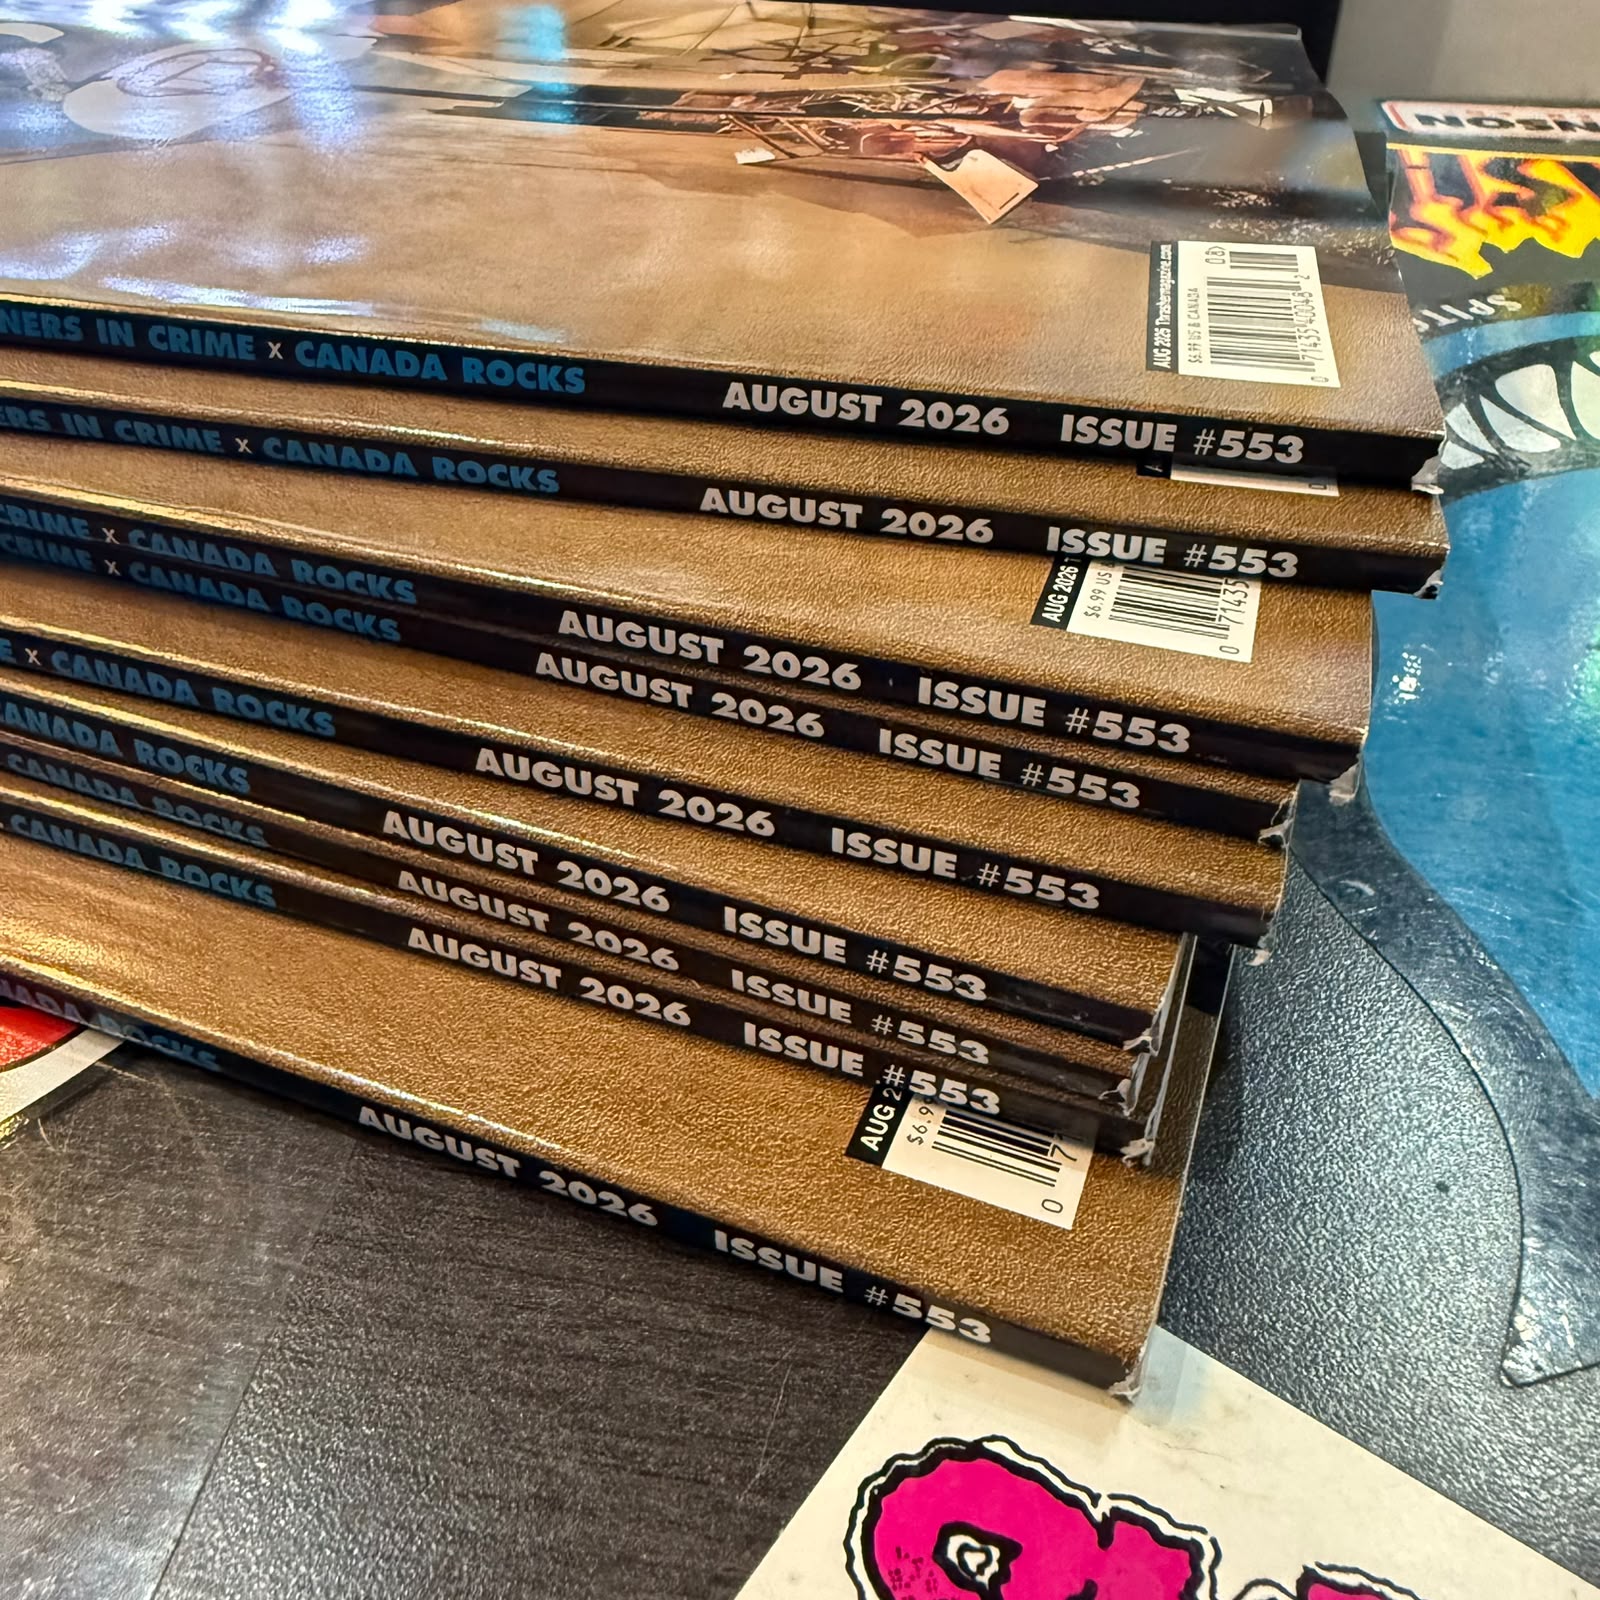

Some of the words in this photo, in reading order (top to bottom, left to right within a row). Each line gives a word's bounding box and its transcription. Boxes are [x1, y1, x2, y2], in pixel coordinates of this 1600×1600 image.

[0, 405, 51, 431] RS
[61, 412, 104, 438] IN
[116, 419, 223, 452] CRIME
[262, 437, 417, 477] CANADA
[432, 456, 560, 494] ROCKS
[700, 486, 863, 529] AUGUST
[881, 509, 994, 544] 2026
[1047, 526, 1166, 565] ISSUE
[1184, 543, 1298, 579] #553
[96, 318, 136, 347] IN
[149, 326, 256, 361] CRIME
[295, 342, 447, 382] CANADA
[462, 356, 586, 395] ROCKS
[723, 382, 882, 423] AUGUST
[898, 398, 1009, 435] 2026
[1061, 414, 1177, 452] ISSUE
[1194, 427, 1304, 464] #553
[128, 529, 278, 577] CANADA
[291, 559, 417, 605] ROCKS
[559, 610, 724, 665] AUGUST
[742, 644, 861, 691] 2026
[917, 677, 1046, 727] ISSUE
[1064, 707, 1190, 754] #553
[129, 561, 271, 612] CANADA
[282, 595, 401, 641] ROCKS
[535, 652, 692, 708] AUGUST
[711, 692, 825, 739] 2026
[879, 729, 1001, 780] ISSUE
[1020, 761, 1140, 809] #553
[1042, 590, 1069, 623] AUG
[1055, 565, 1079, 594] 2026
[1097, 571, 1113, 586] US
[0, 702, 123, 758] ANADA
[134, 738, 250, 795] ROCKS
[382, 810, 538, 875] AUGUST
[557, 861, 670, 913] 2026
[724, 906, 846, 964] ISSUE
[866, 949, 987, 1002] #553
[52, 650, 199, 706] CANADA
[212, 687, 336, 738] ROCKS
[475, 747, 639, 807] AUGUST
[657, 789, 776, 838] 2026
[830, 827, 957, 878] ISSUE
[977, 862, 1100, 910] #553
[7, 753, 143, 807] CANADA
[397, 869, 549, 933] AUGUST
[567, 921, 680, 971] 2026
[731, 968, 851, 1024] ISSUE
[871, 1014, 989, 1066] #553
[10, 814, 148, 869] CANADA
[160, 856, 277, 908] ROCKS
[407, 927, 562, 990] AUGUST
[578, 976, 691, 1027] 2026
[743, 1022, 863, 1077] ISSUE
[883, 1063, 1001, 1115] #553
[357, 1106, 520, 1179] AUGUST
[539, 1171, 658, 1227] 2026
[714, 1230, 843, 1293] ISSUE
[865, 1286, 992, 1344] #553
[860, 1104, 896, 1152] AUG
